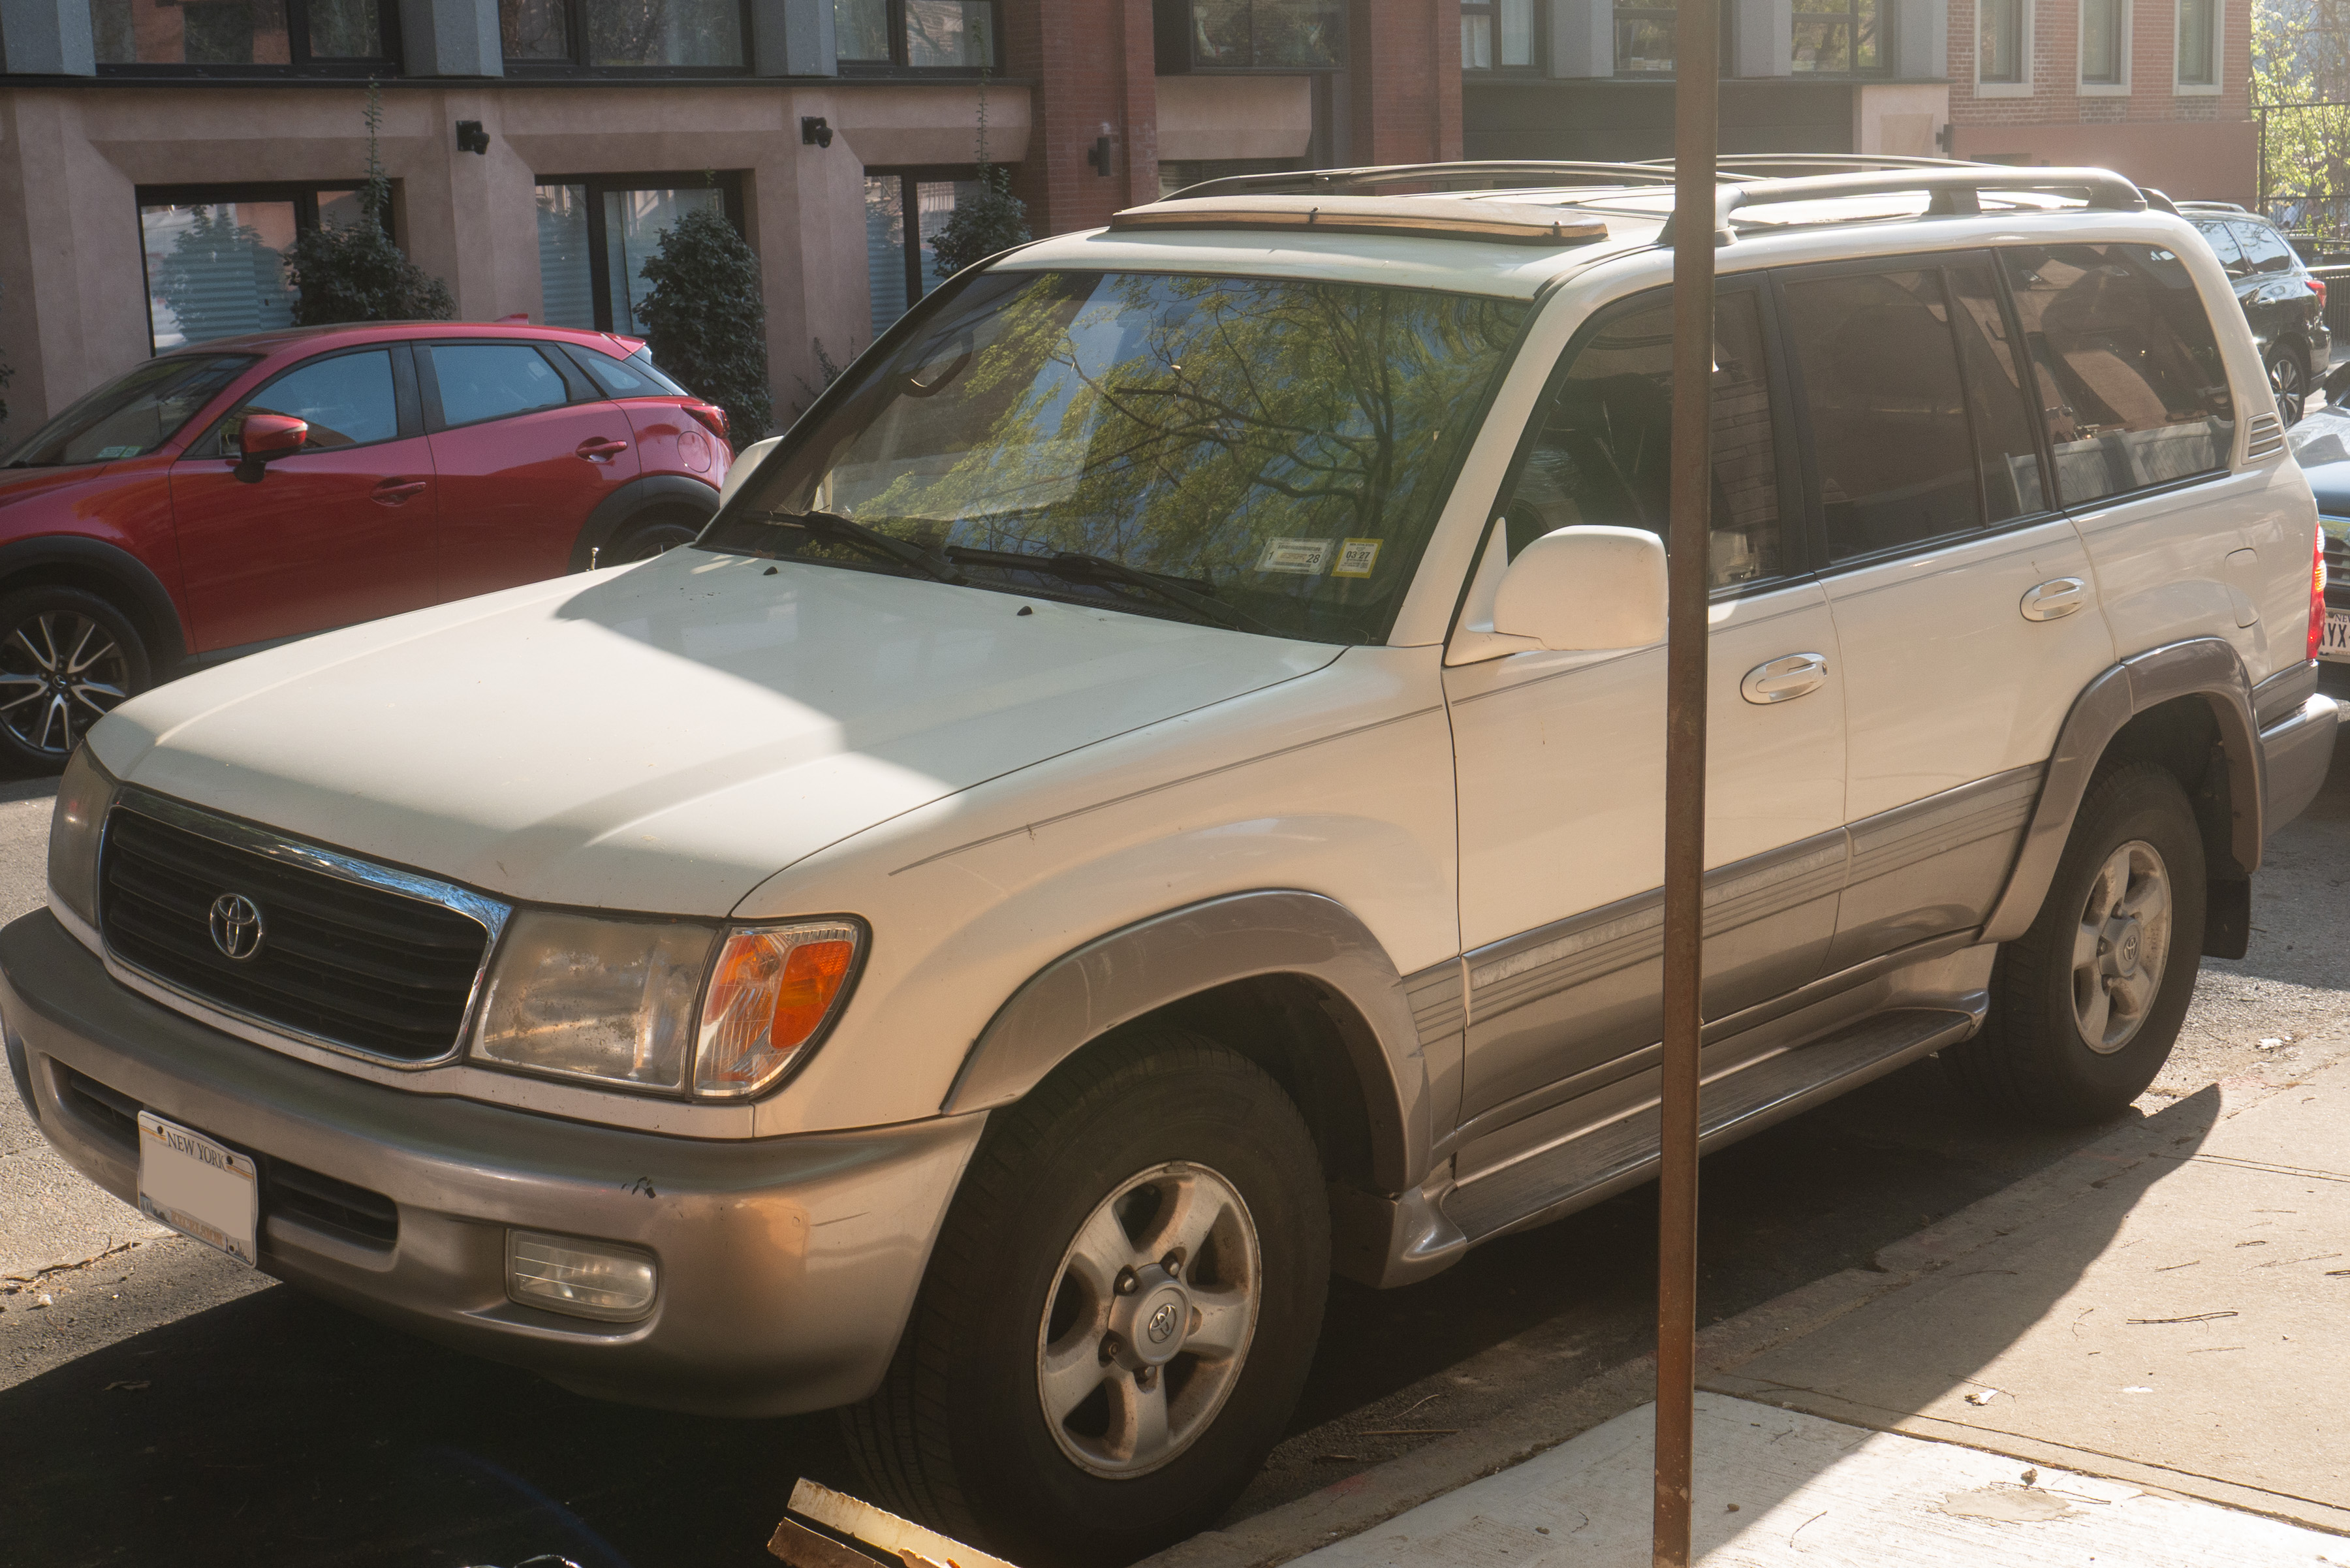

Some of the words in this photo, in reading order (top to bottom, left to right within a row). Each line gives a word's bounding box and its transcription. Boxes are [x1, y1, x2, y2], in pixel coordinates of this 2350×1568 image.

[1306, 554, 1321, 563] 28
[166, 1131, 195, 1156] NEW
[196, 1142, 227, 1172] YORK
